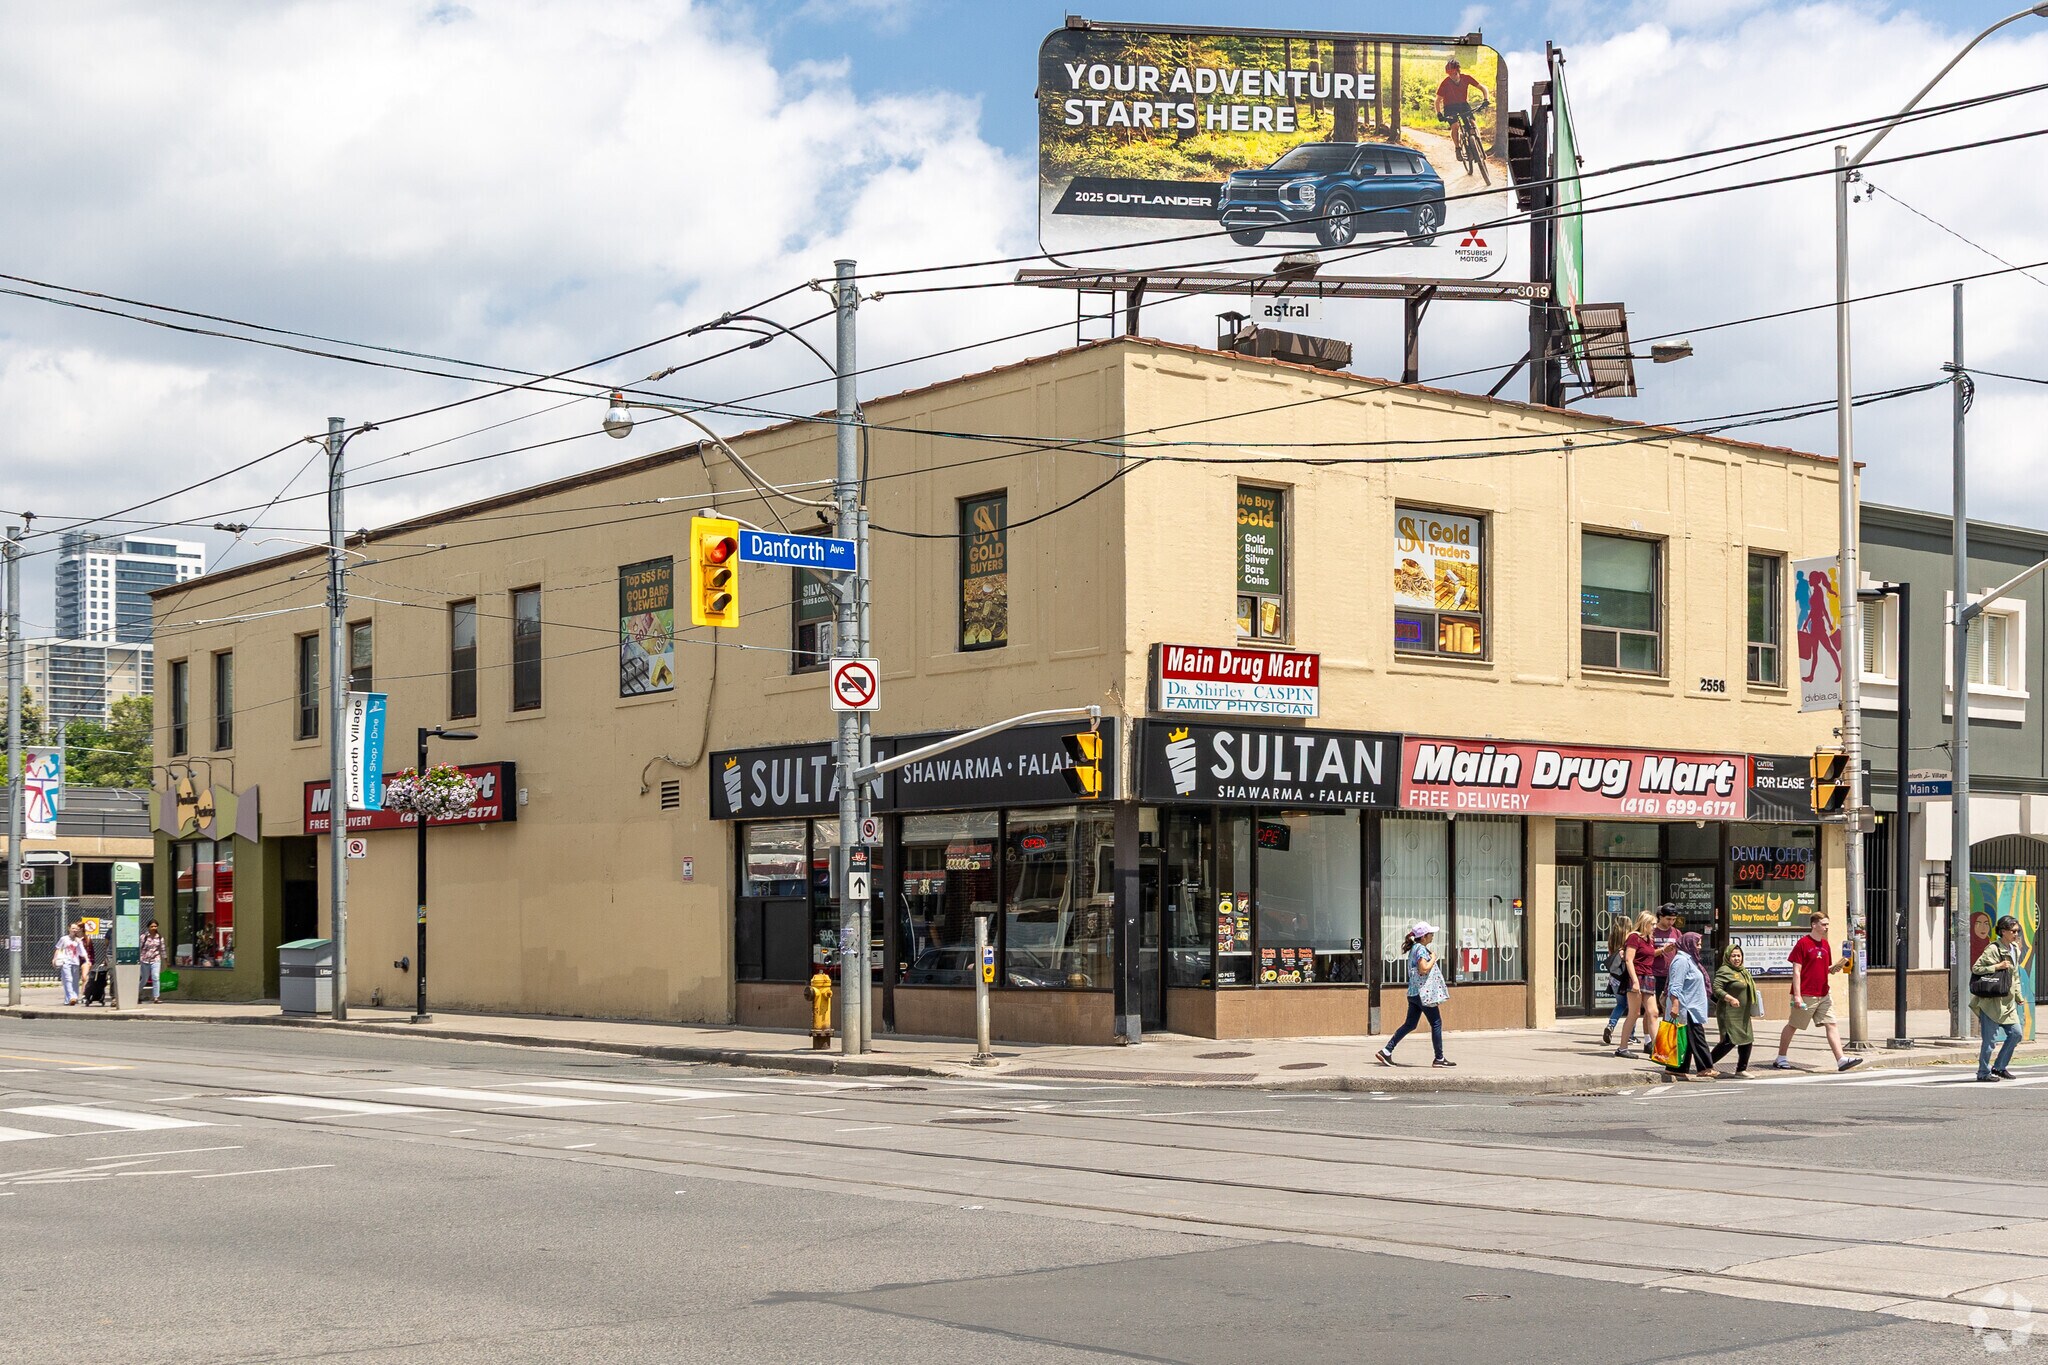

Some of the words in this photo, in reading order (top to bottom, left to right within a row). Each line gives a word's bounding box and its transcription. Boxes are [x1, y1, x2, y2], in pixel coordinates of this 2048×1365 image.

[1064, 63, 1161, 93] YOUR
[1169, 68, 1376, 100] ADVENTURE
[1064, 99, 1196, 130] STARTS
[1206, 104, 1297, 133] HERE
[1075, 191, 1104, 203] 2025
[1106, 193, 1213, 207] OUTLANDER
[1517, 285, 1549, 298] 3019
[1264, 303, 1309, 317] astral
[1237, 493, 1253, 506] We
[1255, 496, 1275, 511] Buy
[1237, 508, 1274, 528] Gold
[1245, 533, 1265, 544] Gold
[1428, 521, 1470, 545] Gold
[751, 535, 825, 562] Danforth
[829, 543, 845, 555] Ave
[969, 542, 1004, 563] GOLD
[1245, 544, 1274, 555] Bullion
[1428, 543, 1470, 560] Traders
[970, 558, 1003, 574] BUYERS
[1245, 554, 1269, 565] Silver
[625, 574, 640, 587] Top
[641, 570, 656, 584] $$$
[657, 568, 671, 579] For
[1245, 564, 1264, 575] Bars
[1245, 574, 1270, 586] Coins
[626, 588, 648, 601] GOLD
[649, 583, 669, 598] BARS
[628, 602, 633, 613] &
[633, 595, 668, 612] JEWELRY
[1167, 646, 1214, 674] Main
[1219, 650, 1264, 682] Drug
[1267, 653, 1312, 679] Mart
[1195, 681, 1245, 698] Shirley
[1254, 685, 1313, 701] CASPIN
[1167, 698, 1220, 711] FAMILY
[1227, 701, 1313, 715] PHYSICIAN
[351, 700, 362, 743] Village
[371, 718, 379, 739] Dine
[369, 747, 378, 772] Shop
[1210, 731, 1383, 785] SULTAN
[351, 747, 359, 802] Danforth
[903, 756, 1003, 784] SHAWARMA
[1411, 744, 1522, 788] Main
[1531, 750, 1631, 798] Drug
[1639, 756, 1736, 797] Mart
[1757, 777, 1776, 788] FOR
[1777, 778, 1805, 789] LEASE
[1910, 784, 1930, 794] Main
[1932, 785, 1939, 793] St
[1217, 785, 1303, 801] SHAWARMA
[1319, 789, 1376, 804] FALAFEL
[1409, 789, 1449, 808] FREE
[1457, 791, 1530, 810] DELIVERY
[1620, 797, 1660, 815] (416)
[1665, 799, 1737, 816] 699-6171
[310, 819, 329, 829] FREE
[1023, 838, 1047, 849] OPEN
[1731, 846, 1772, 861] DENTAL
[1776, 847, 1814, 862] OFFICE
[1732, 895, 1748, 910] SN
[1748, 894, 1765, 903] Gold
[1742, 914, 1752, 922] Buy
